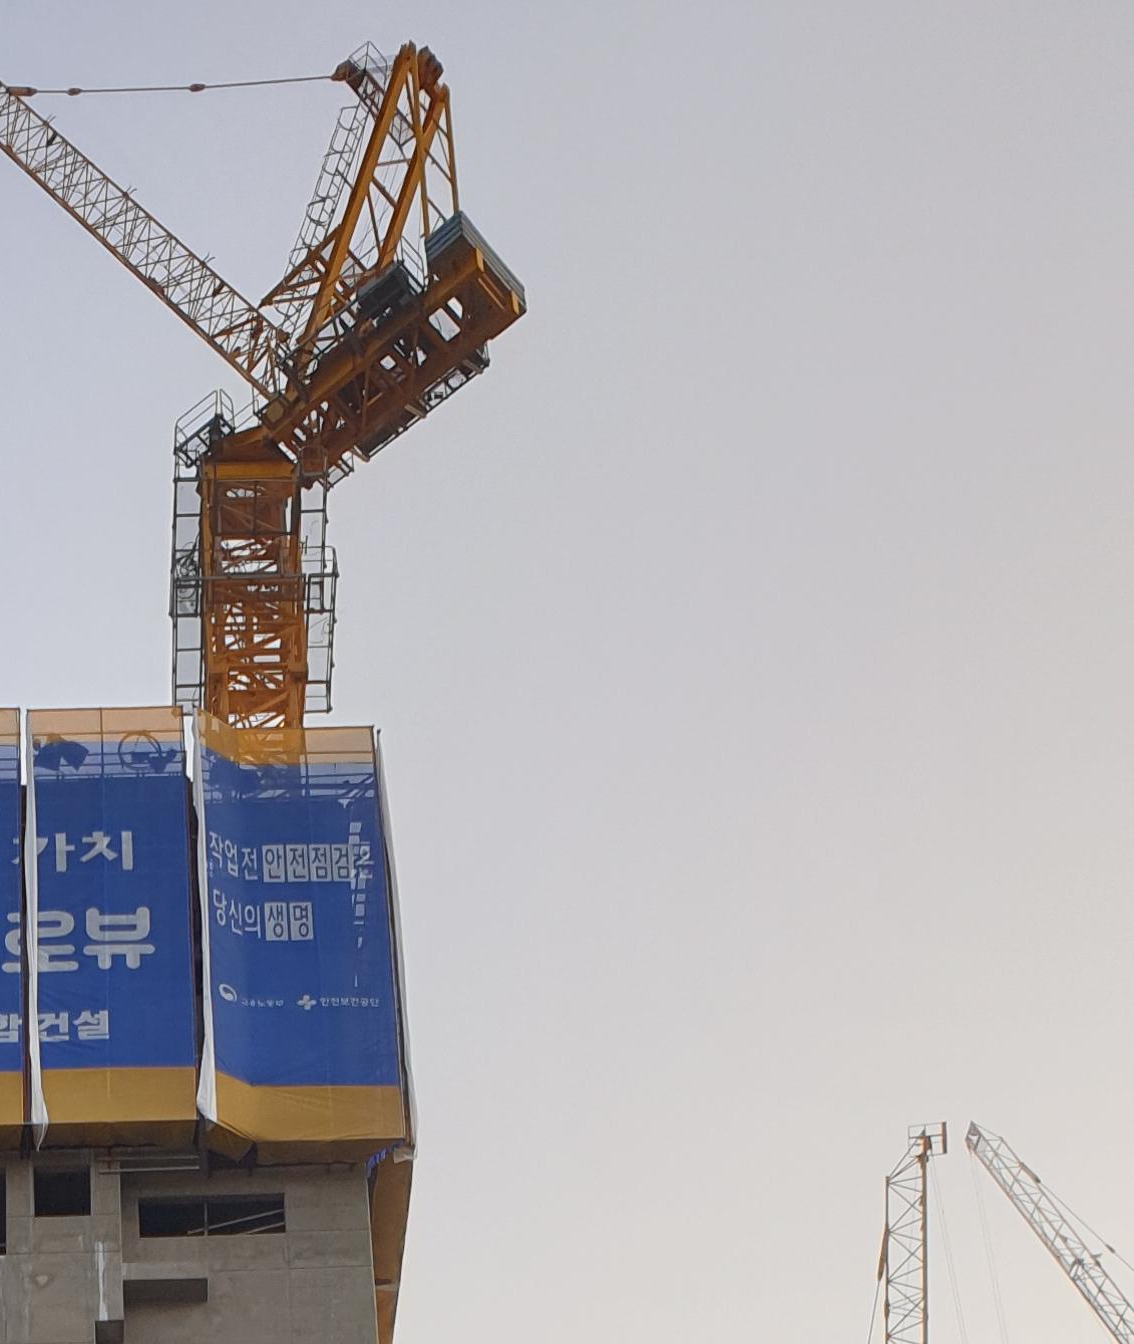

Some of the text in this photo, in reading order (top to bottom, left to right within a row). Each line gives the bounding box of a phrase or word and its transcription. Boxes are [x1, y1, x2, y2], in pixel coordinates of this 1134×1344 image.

[12, 831, 134, 872] 가치
[209, 831, 240, 877] 작업
[241, 848, 258, 880] 전
[212, 889, 314, 941] 당신의 생명
